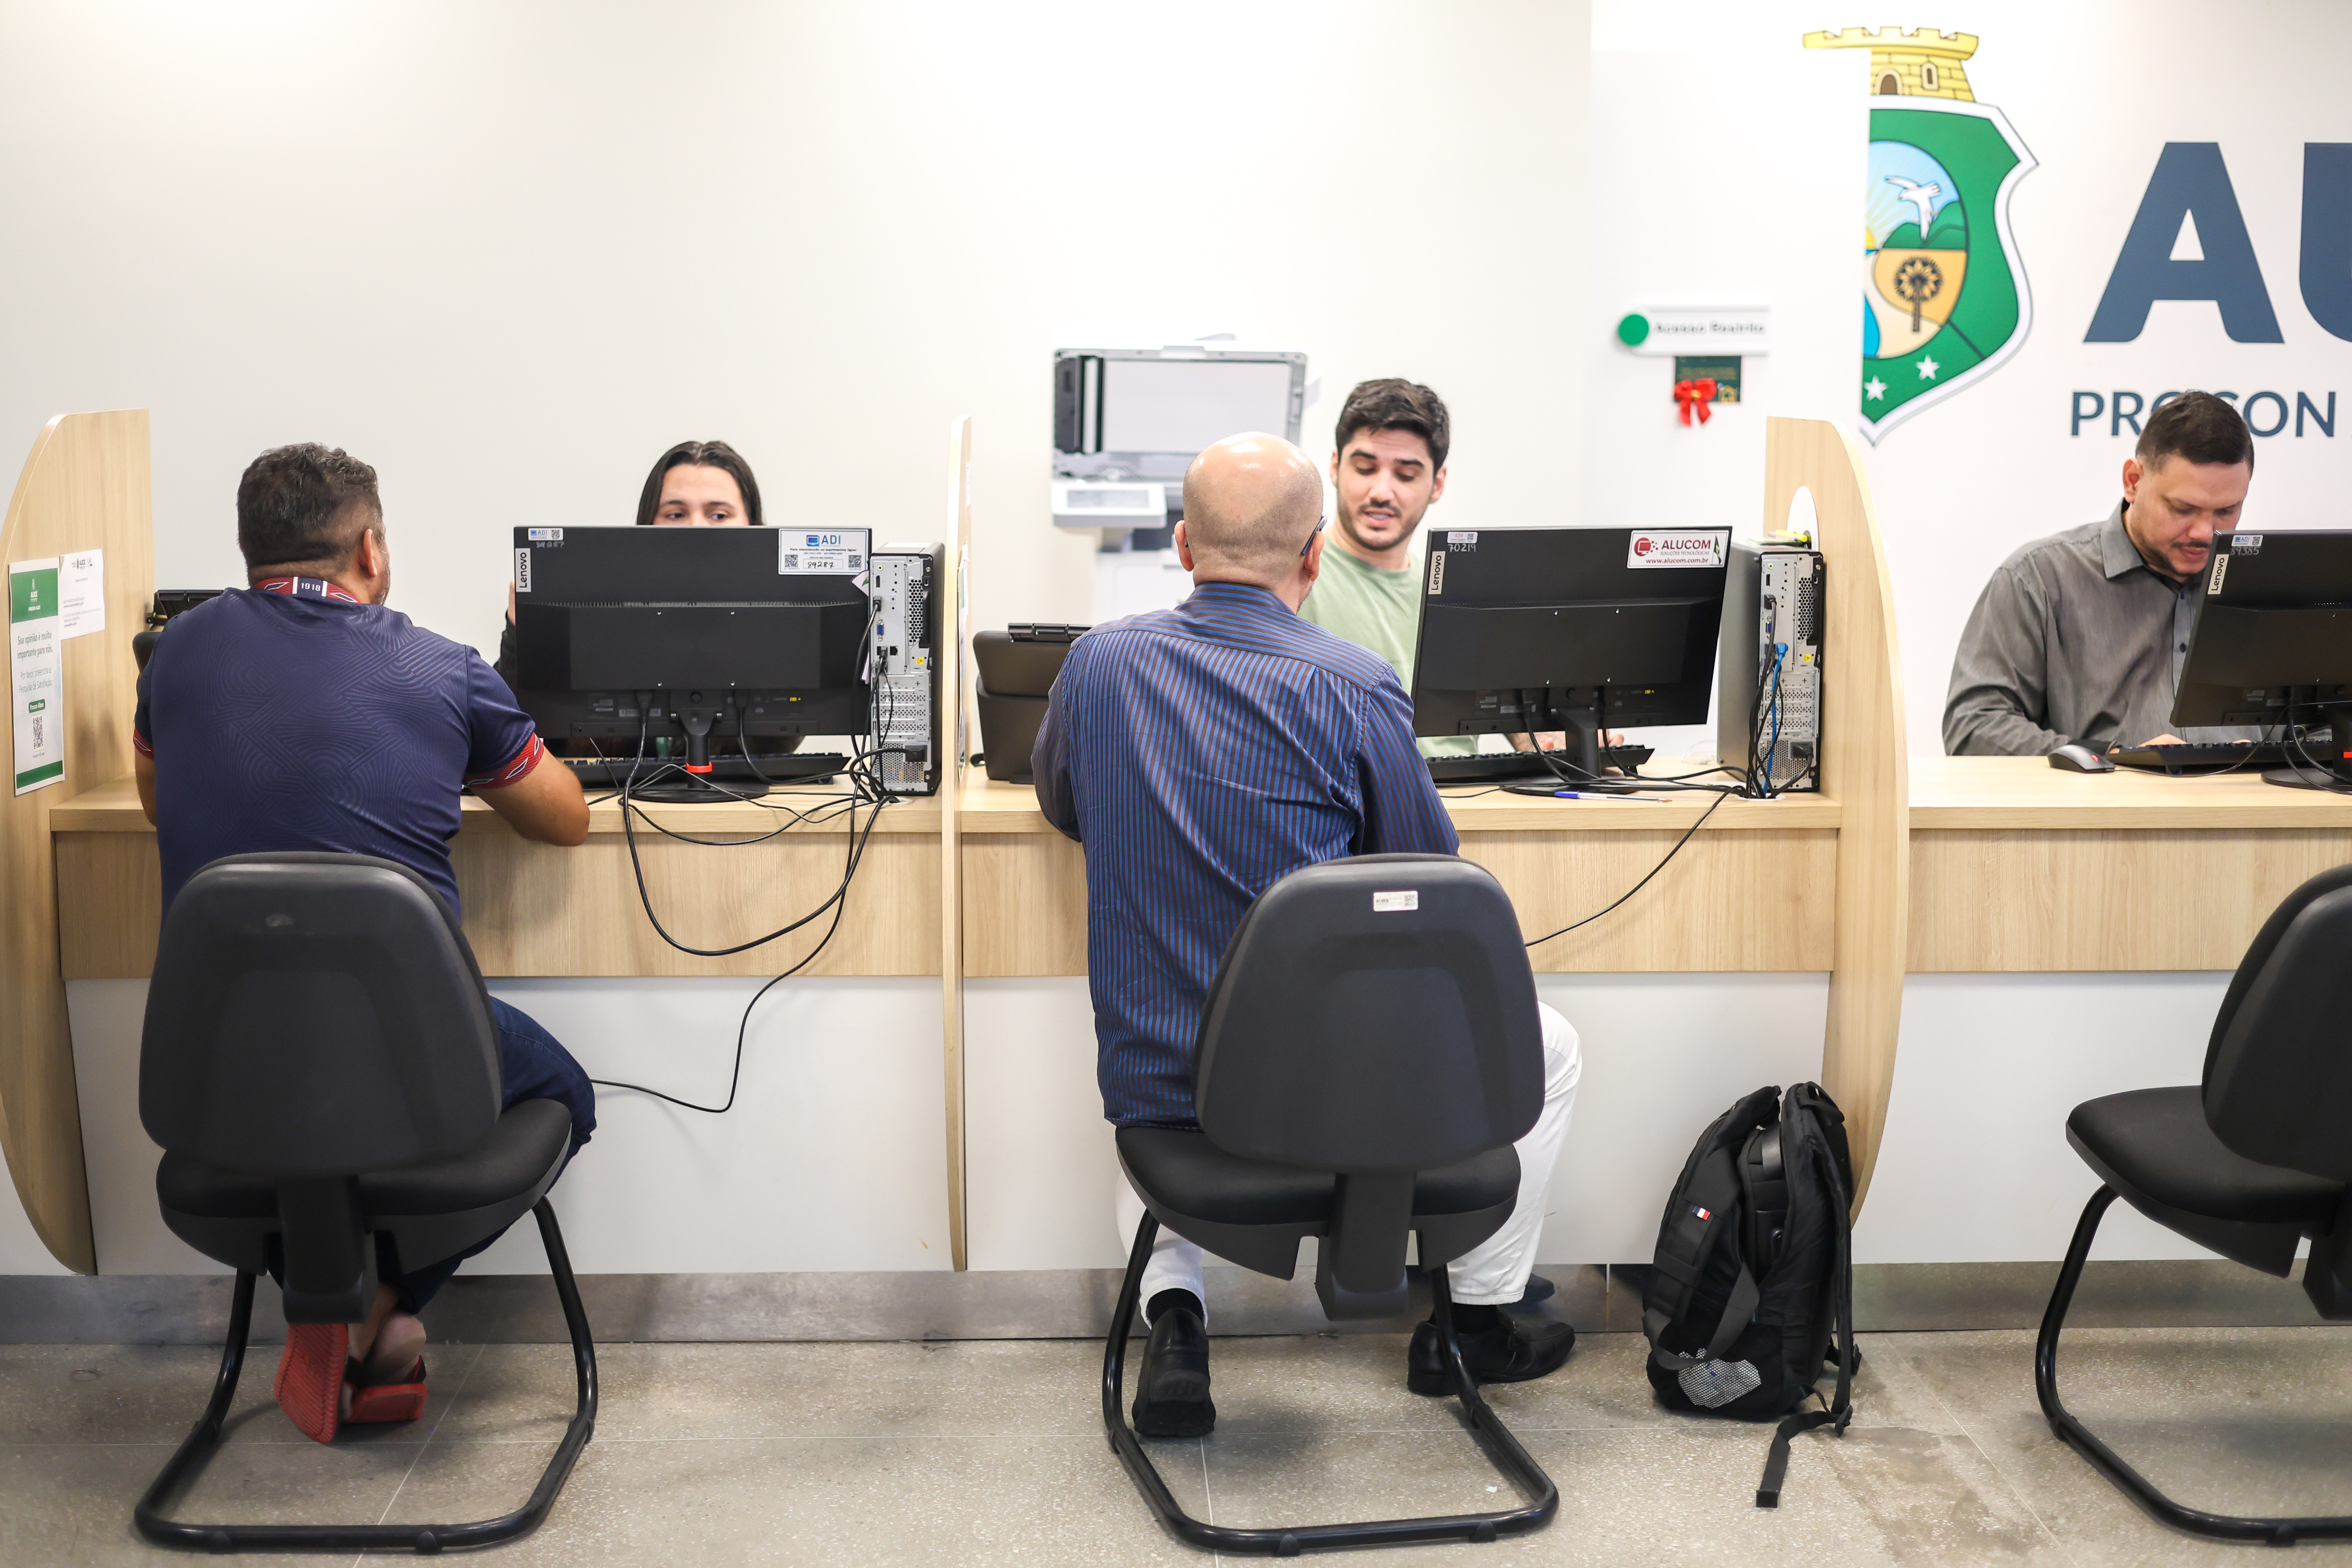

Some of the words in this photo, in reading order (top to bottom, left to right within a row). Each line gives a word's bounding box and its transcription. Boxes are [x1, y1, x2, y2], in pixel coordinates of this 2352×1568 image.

[2071, 391, 2336, 437] PRON
[822, 535, 840, 544] ADI
[1661, 540, 1711, 550] ALUCOM
[1448, 544, 1476, 552] 70219
[1431, 555, 1441, 590] Lenovo
[2211, 558, 2225, 591] Lenovo
[301, 583, 321, 591] 1918
[25, 633, 37, 646] opinião
[38, 632, 40, 640] é
[41, 630, 52, 640] muito
[17, 648, 36, 661] importante
[35, 666, 48, 679] preencha
[19, 683, 32, 694] Pesquisa
